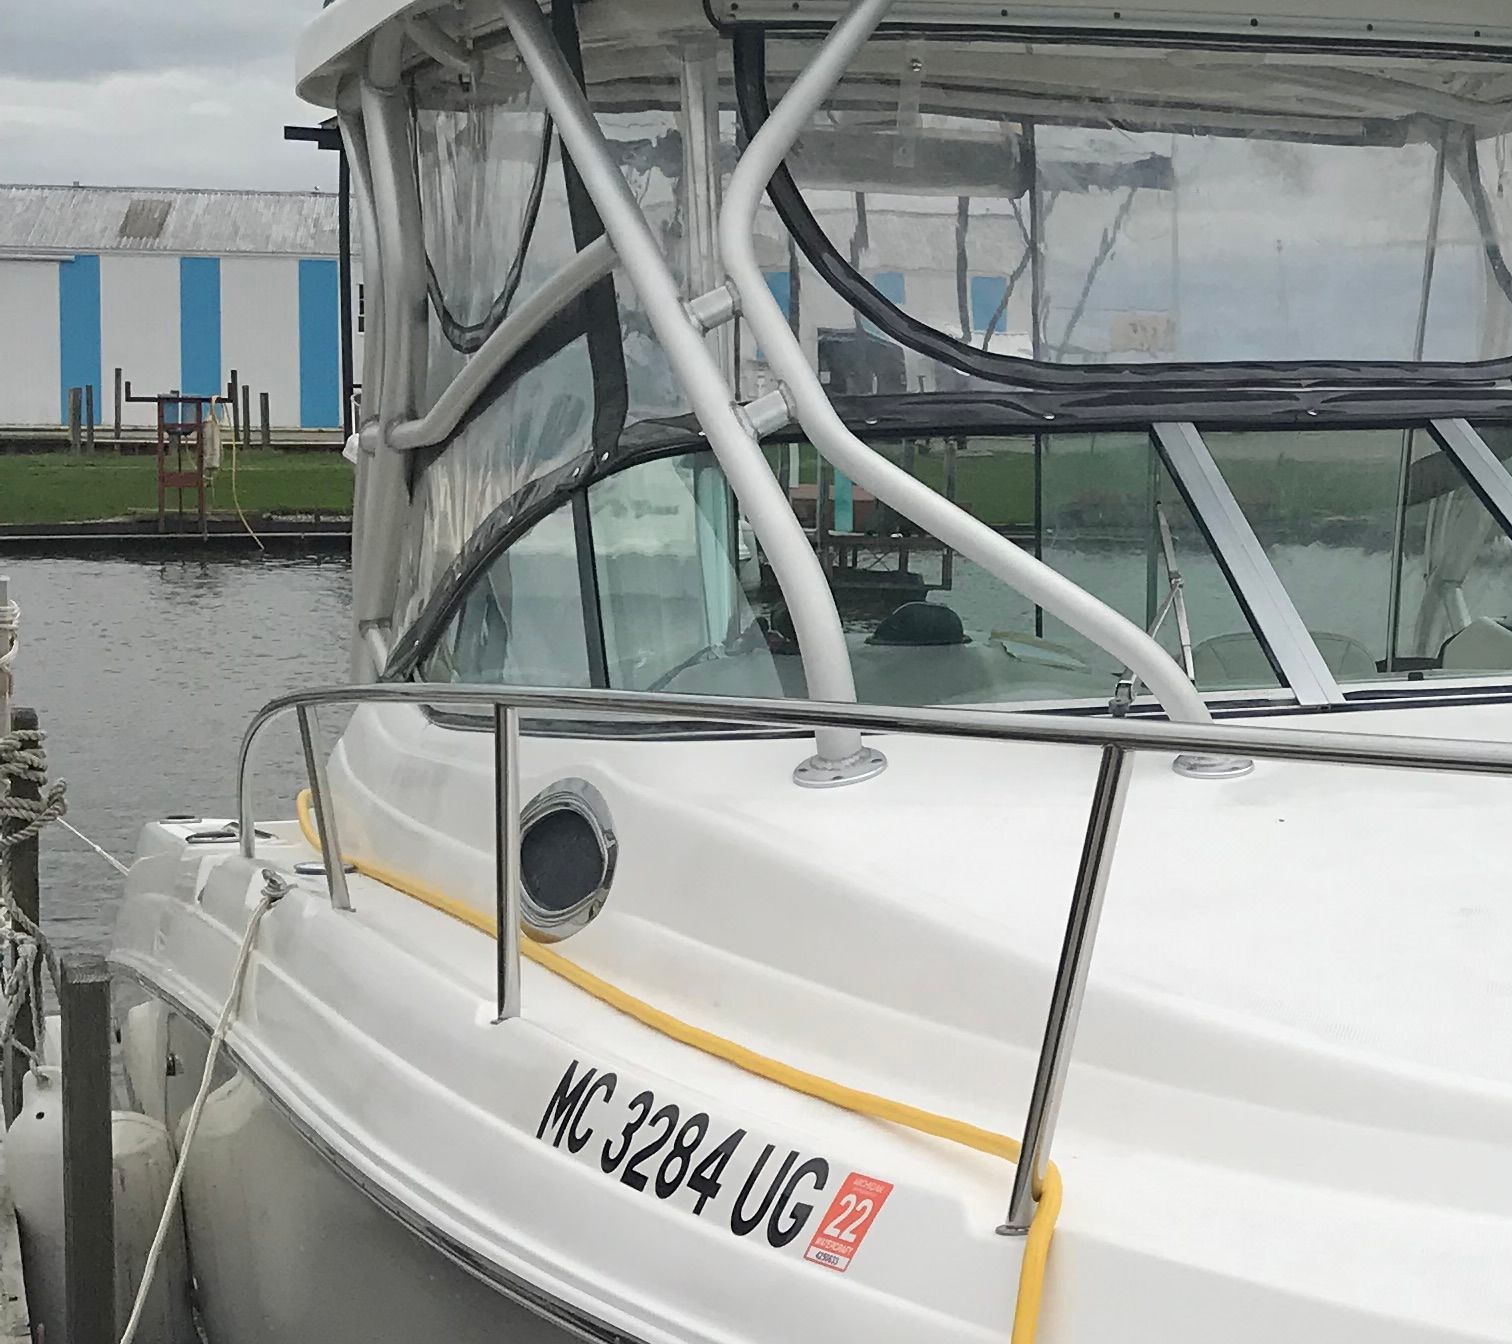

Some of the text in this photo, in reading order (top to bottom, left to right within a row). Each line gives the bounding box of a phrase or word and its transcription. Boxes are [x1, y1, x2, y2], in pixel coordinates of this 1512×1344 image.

[535, 1059, 830, 1249] MC 3284 UG
[823, 1193, 874, 1243] 22
